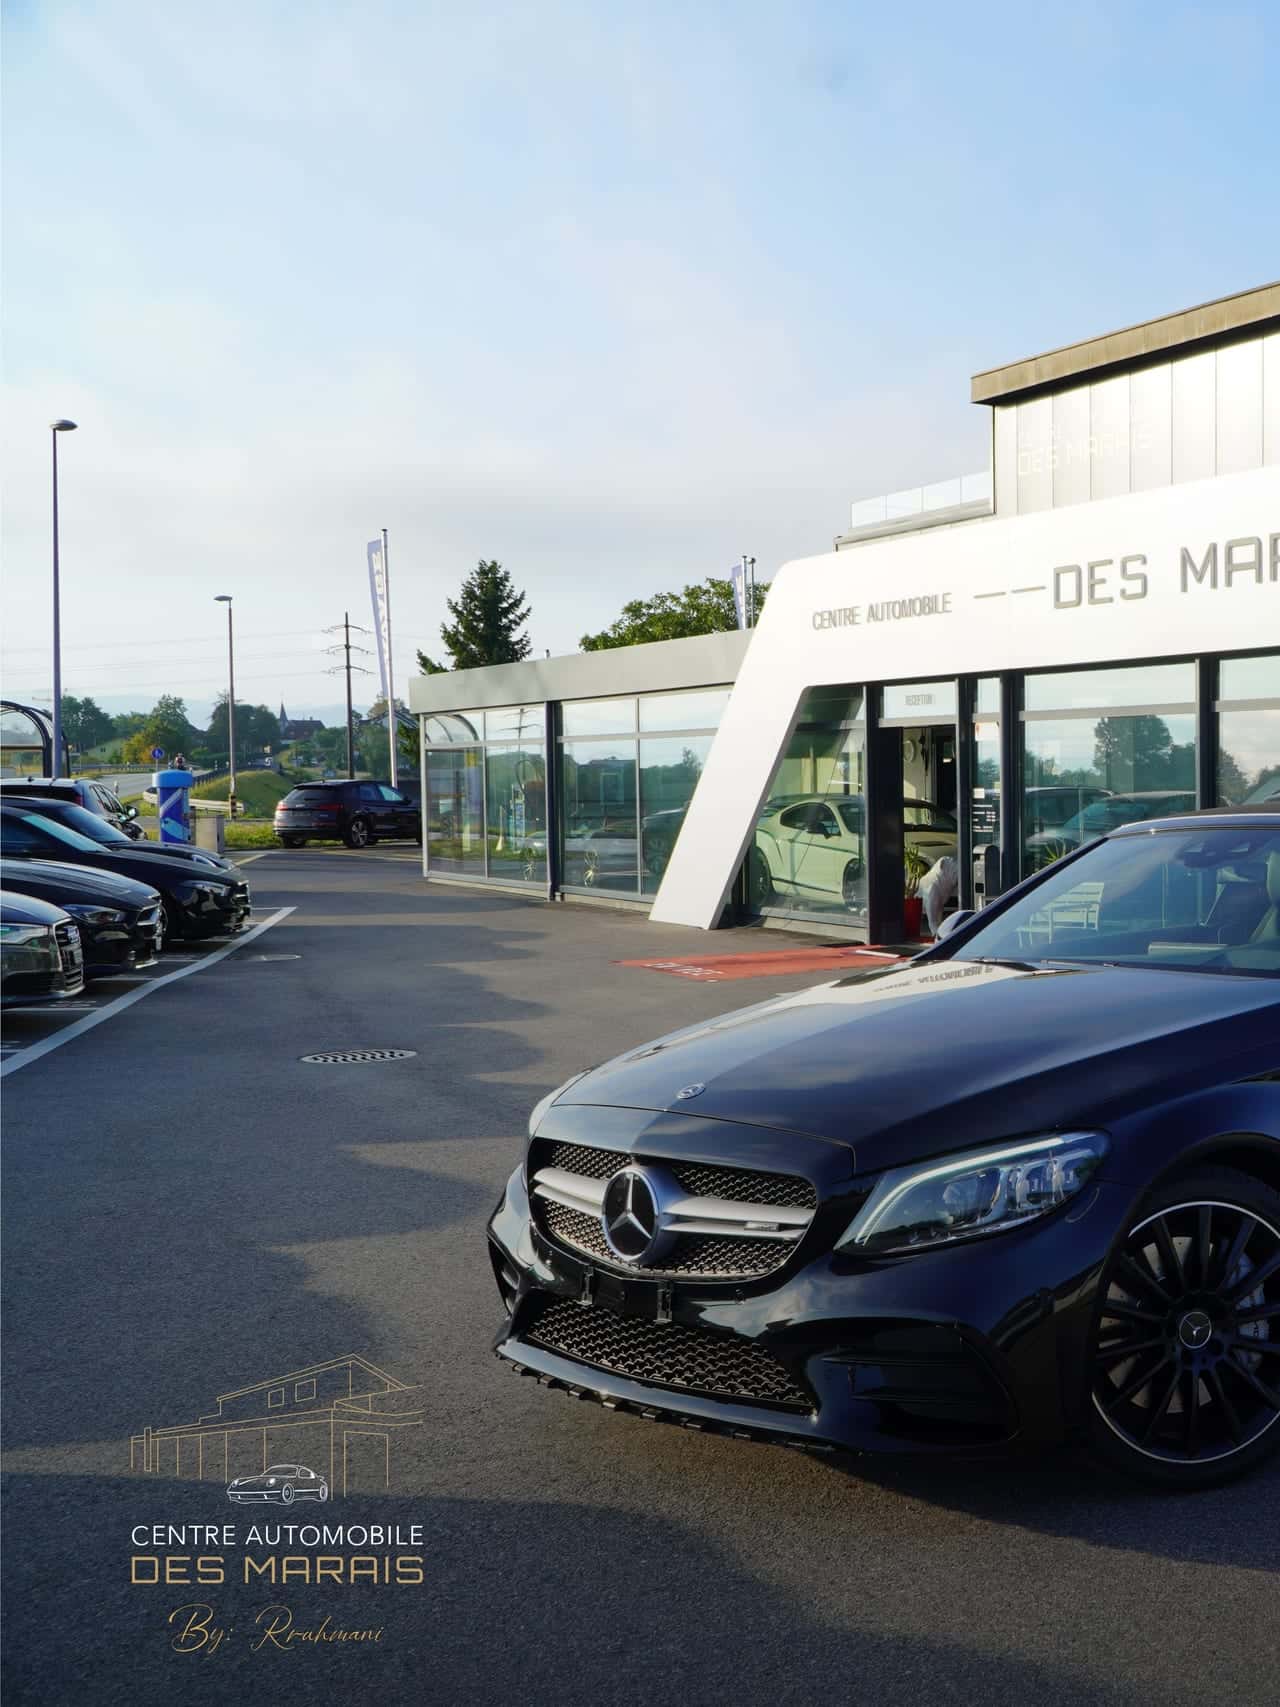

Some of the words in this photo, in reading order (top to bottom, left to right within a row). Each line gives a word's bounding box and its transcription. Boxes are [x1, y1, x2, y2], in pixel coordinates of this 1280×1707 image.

[1053, 554, 1148, 609] DES
[812, 606, 861, 630] CENTRE
[866, 592, 952, 623] AUTOMOBILE
